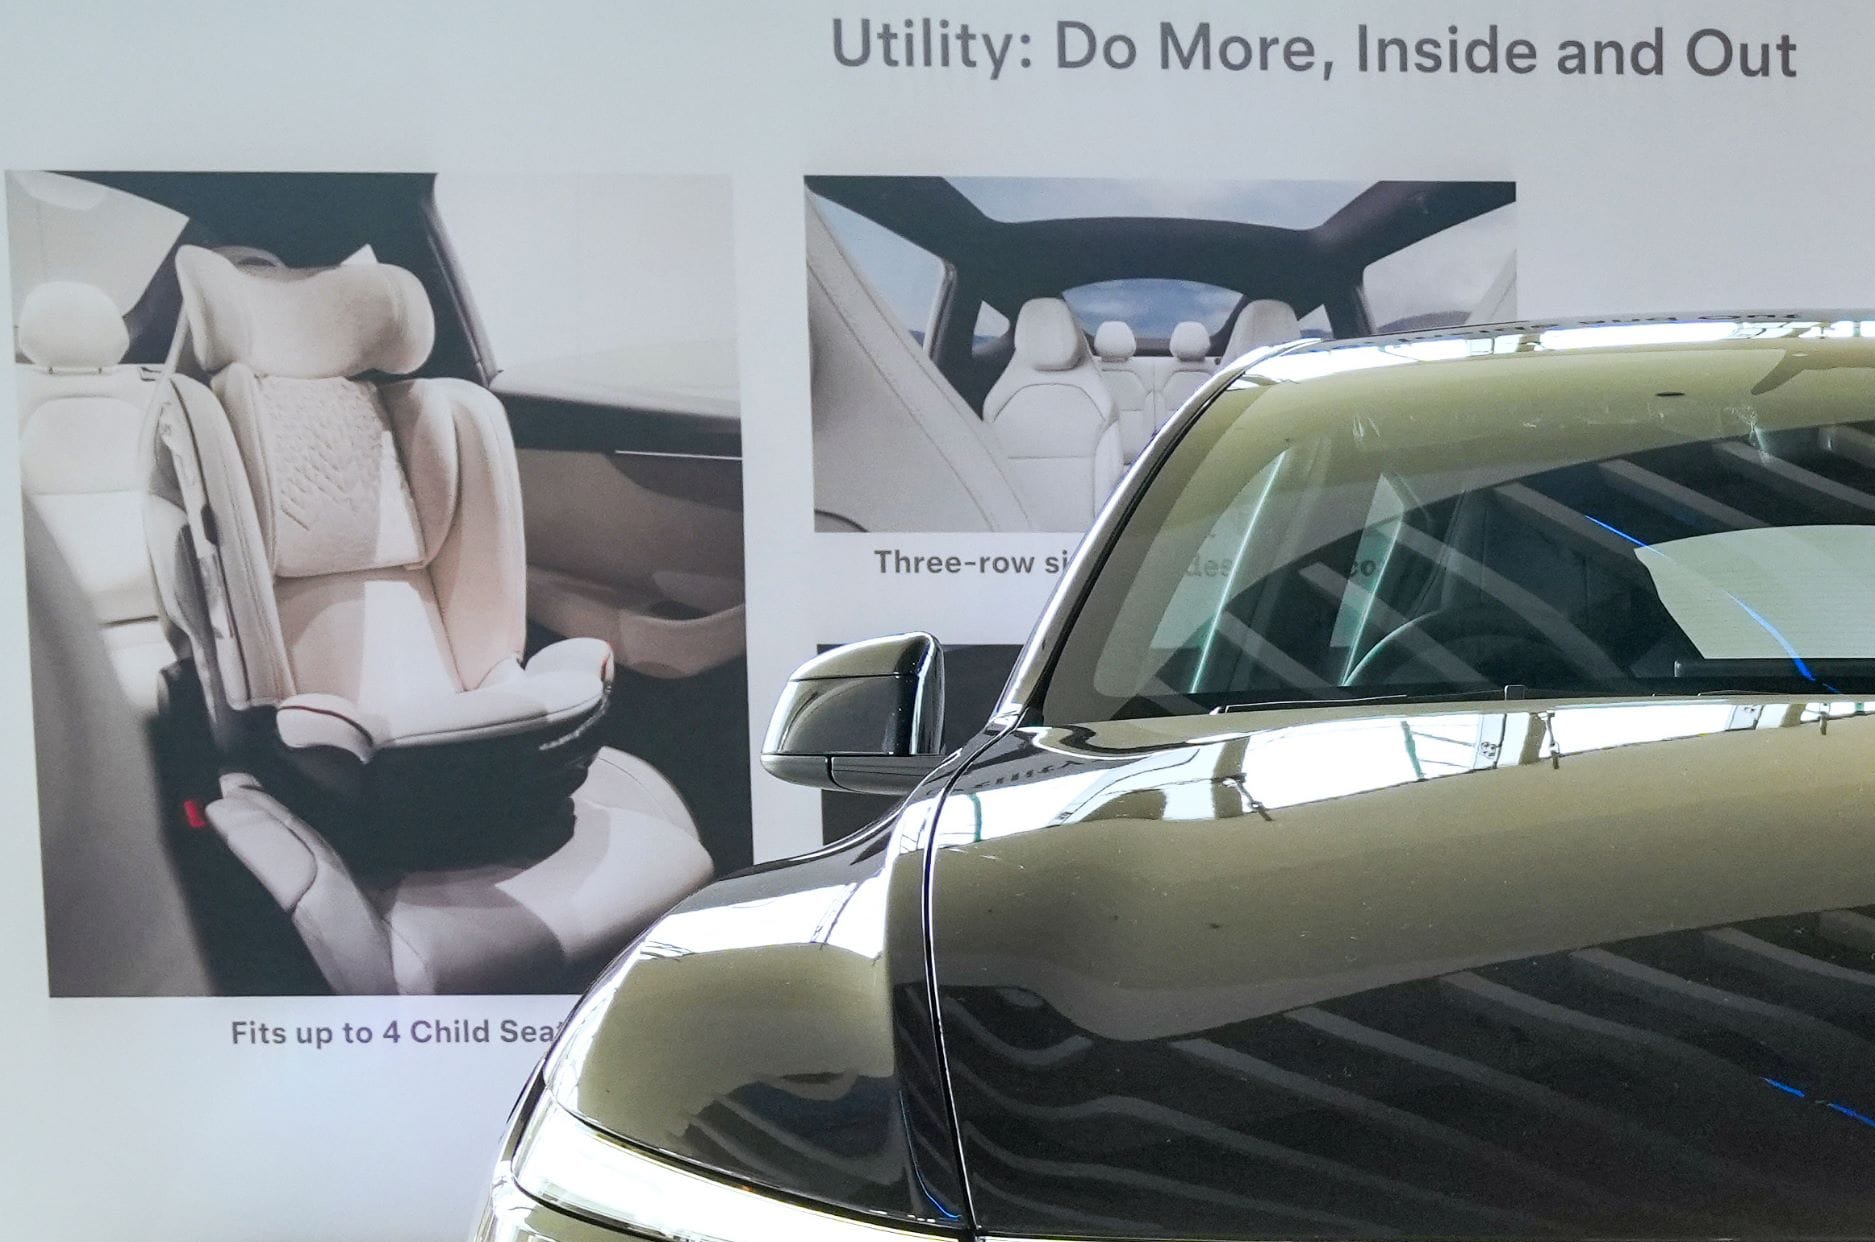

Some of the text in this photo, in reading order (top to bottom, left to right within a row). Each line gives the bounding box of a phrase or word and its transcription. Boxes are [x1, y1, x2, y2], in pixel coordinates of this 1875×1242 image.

[832, 17, 1798, 82] Utility: Do More, Inside and Out
[873, 548, 1036, 574] Three-row
[231, 1018, 559, 1050] Fits up to 4 Child Sea
